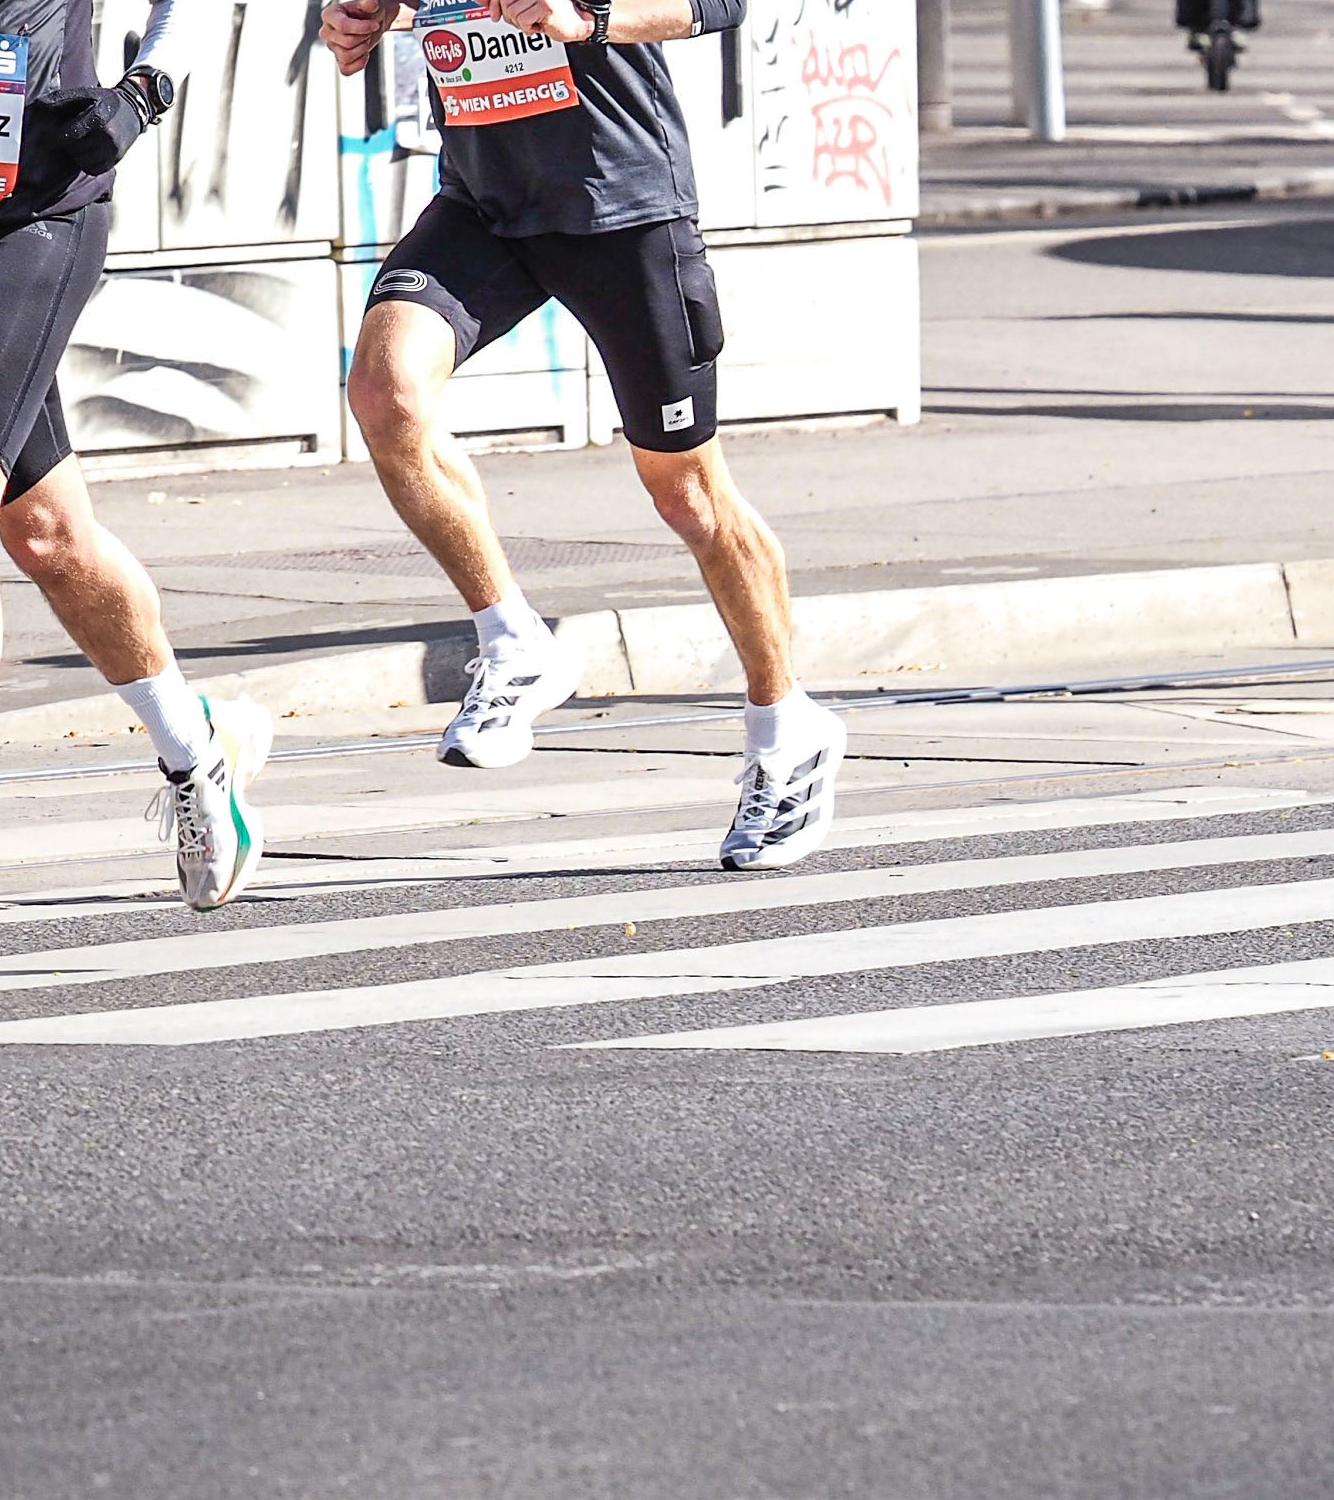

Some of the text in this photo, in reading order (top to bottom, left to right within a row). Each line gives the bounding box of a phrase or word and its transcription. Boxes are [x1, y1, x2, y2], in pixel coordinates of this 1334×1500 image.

[424, 39, 463, 63] Hervis
[505, 62, 525, 74] 4212
[459, 95, 491, 114] WIEN
